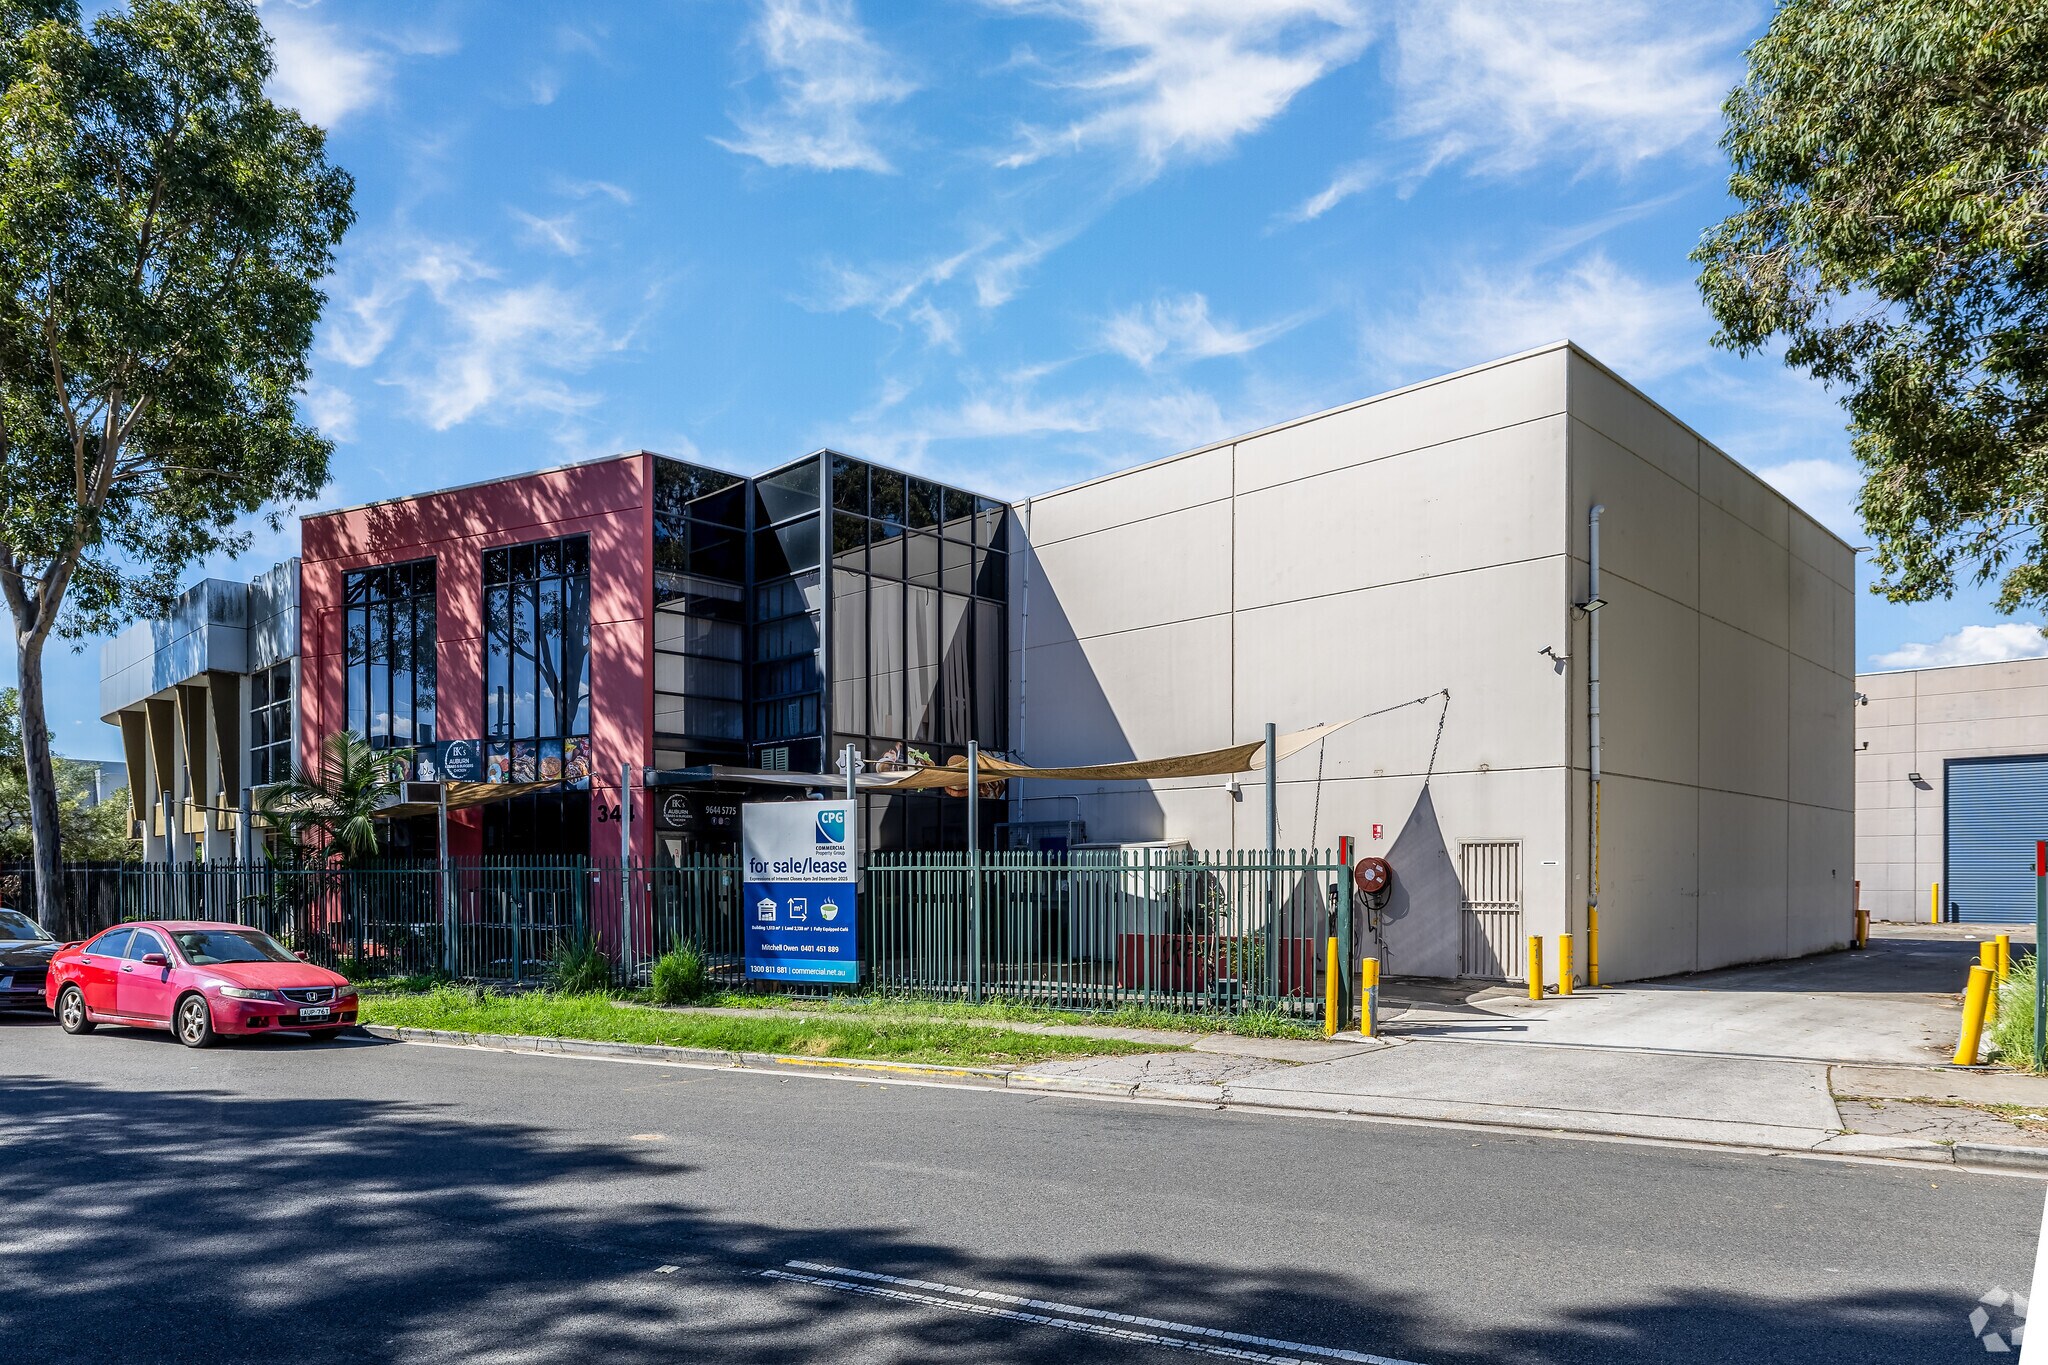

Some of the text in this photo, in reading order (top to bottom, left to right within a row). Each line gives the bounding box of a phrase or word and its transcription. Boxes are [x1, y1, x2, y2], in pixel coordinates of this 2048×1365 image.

[420, 765, 434, 776] حلال
[705, 805, 737, 815] 9644 5775
[821, 811, 844, 824] CPG
[749, 857, 847, 875] for sale/lease
[761, 943, 783, 952] Mitchell
[750, 965, 765, 974] 1300
[791, 966, 846, 977] commercial.net.au
